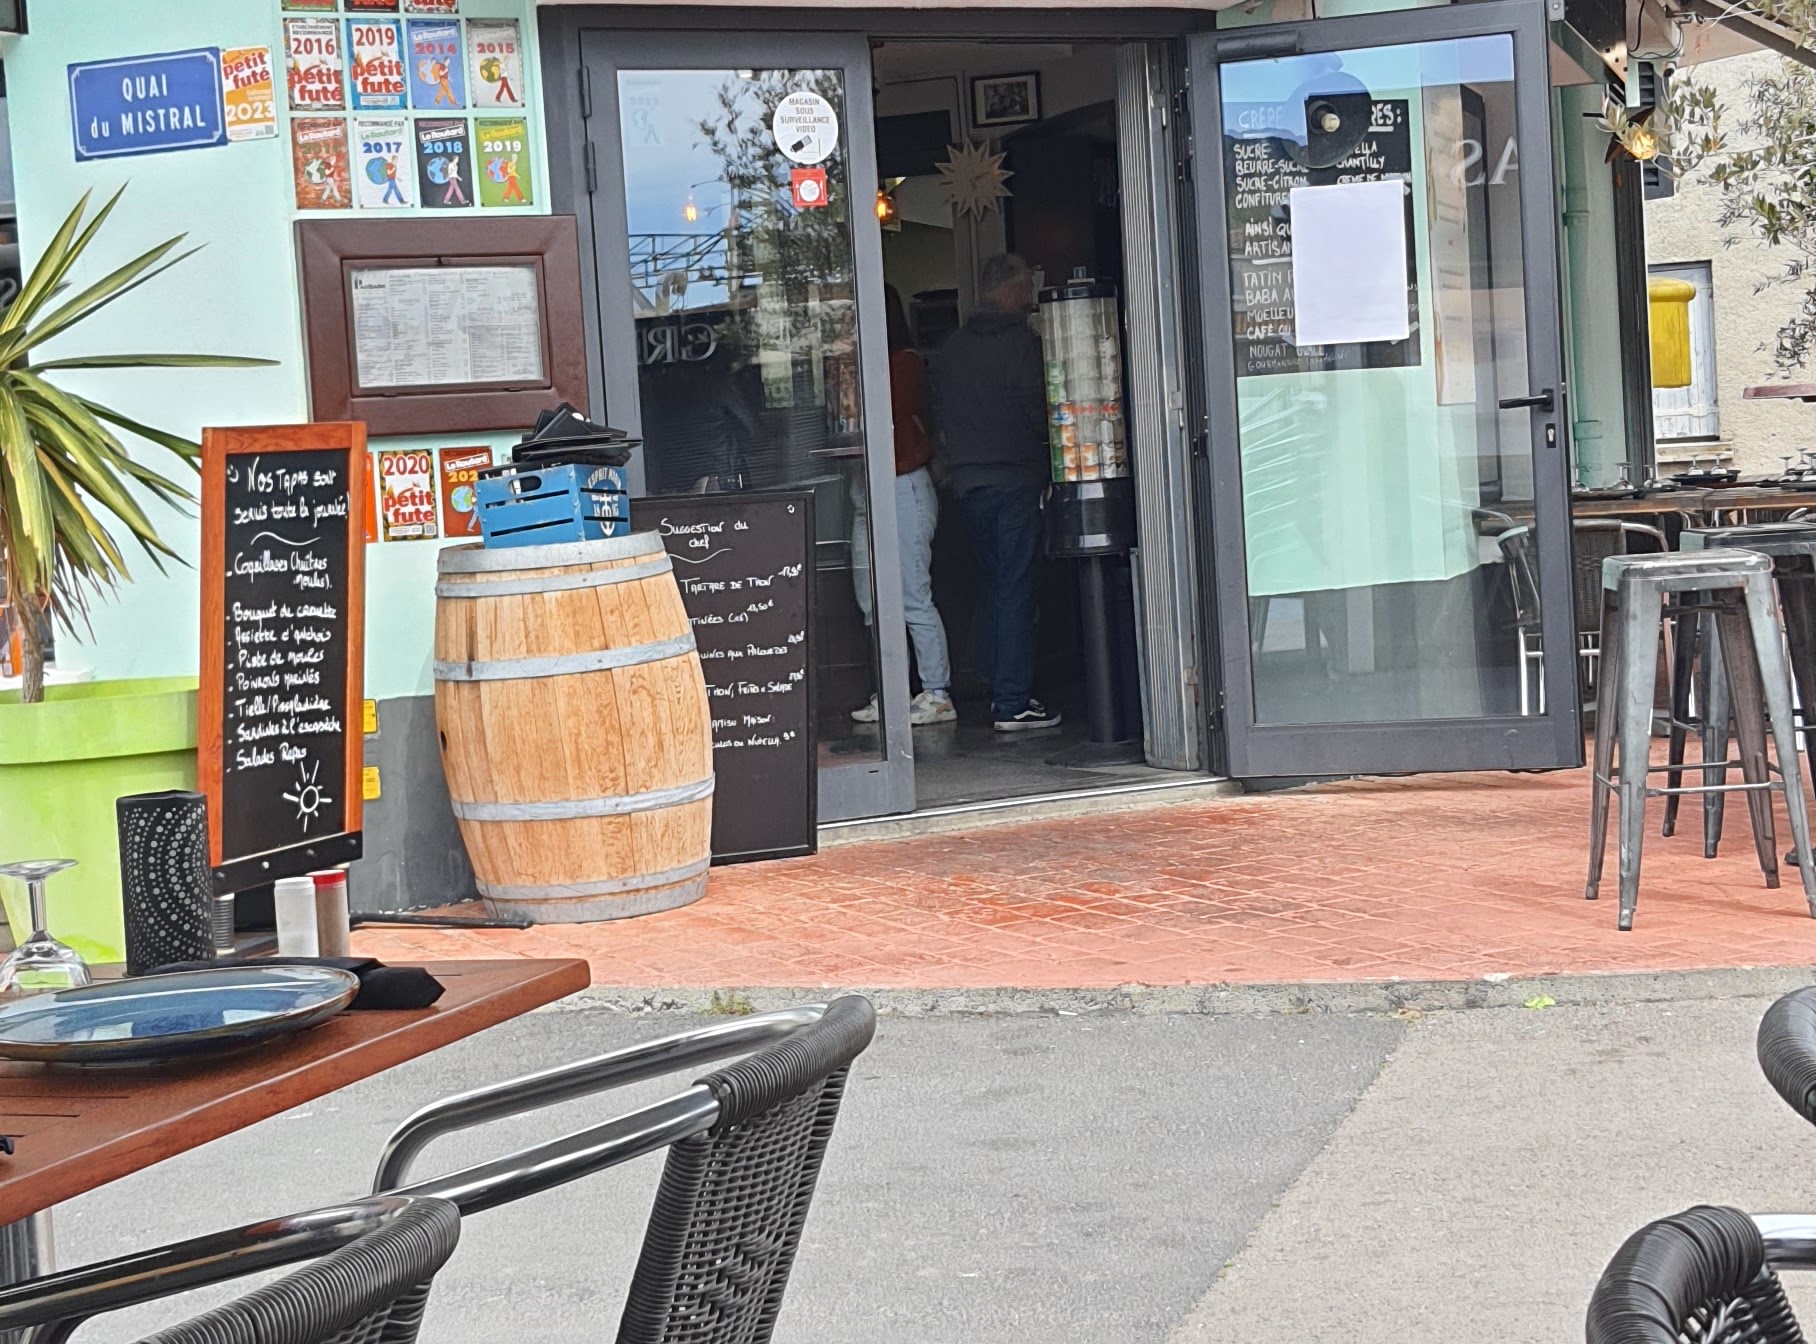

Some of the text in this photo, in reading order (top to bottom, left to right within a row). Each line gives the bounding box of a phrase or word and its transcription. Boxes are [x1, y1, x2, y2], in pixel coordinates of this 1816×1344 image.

[355, 27, 395, 46] 2019
[293, 38, 335, 55] 2016
[415, 43, 457, 55] 2014
[477, 43, 515, 54] 2015
[223, 51, 267, 80] petit
[351, 60, 403, 81] petit
[233, 67, 270, 91] futé
[288, 67, 343, 90] petit
[122, 74, 168, 102] QUAI
[227, 100, 275, 122] 2023
[91, 105, 206, 139] du MISTRAL
[780, 116, 830, 124] SURVEILLANCE
[363, 142, 402, 153] 2017
[423, 142, 463, 153] 2018
[483, 141, 521, 152] 2019
[1233, 143, 1271, 159] SUCRE
[1243, 267, 1283, 288] TATIN
[1246, 288, 1279, 306] BABA
[1247, 306, 1293, 323] MOELLEU
[1249, 342, 1289, 358] NOUGAT
[248, 456, 274, 492] Nos
[384, 456, 430, 475] 2020
[448, 470, 478, 483] 202
[384, 490, 433, 512] petit
[734, 519, 749, 531] du
[688, 533, 709, 549] chef
[280, 603, 294, 618] de
[269, 648, 285, 665] de
[236, 745, 275, 770] Salades
